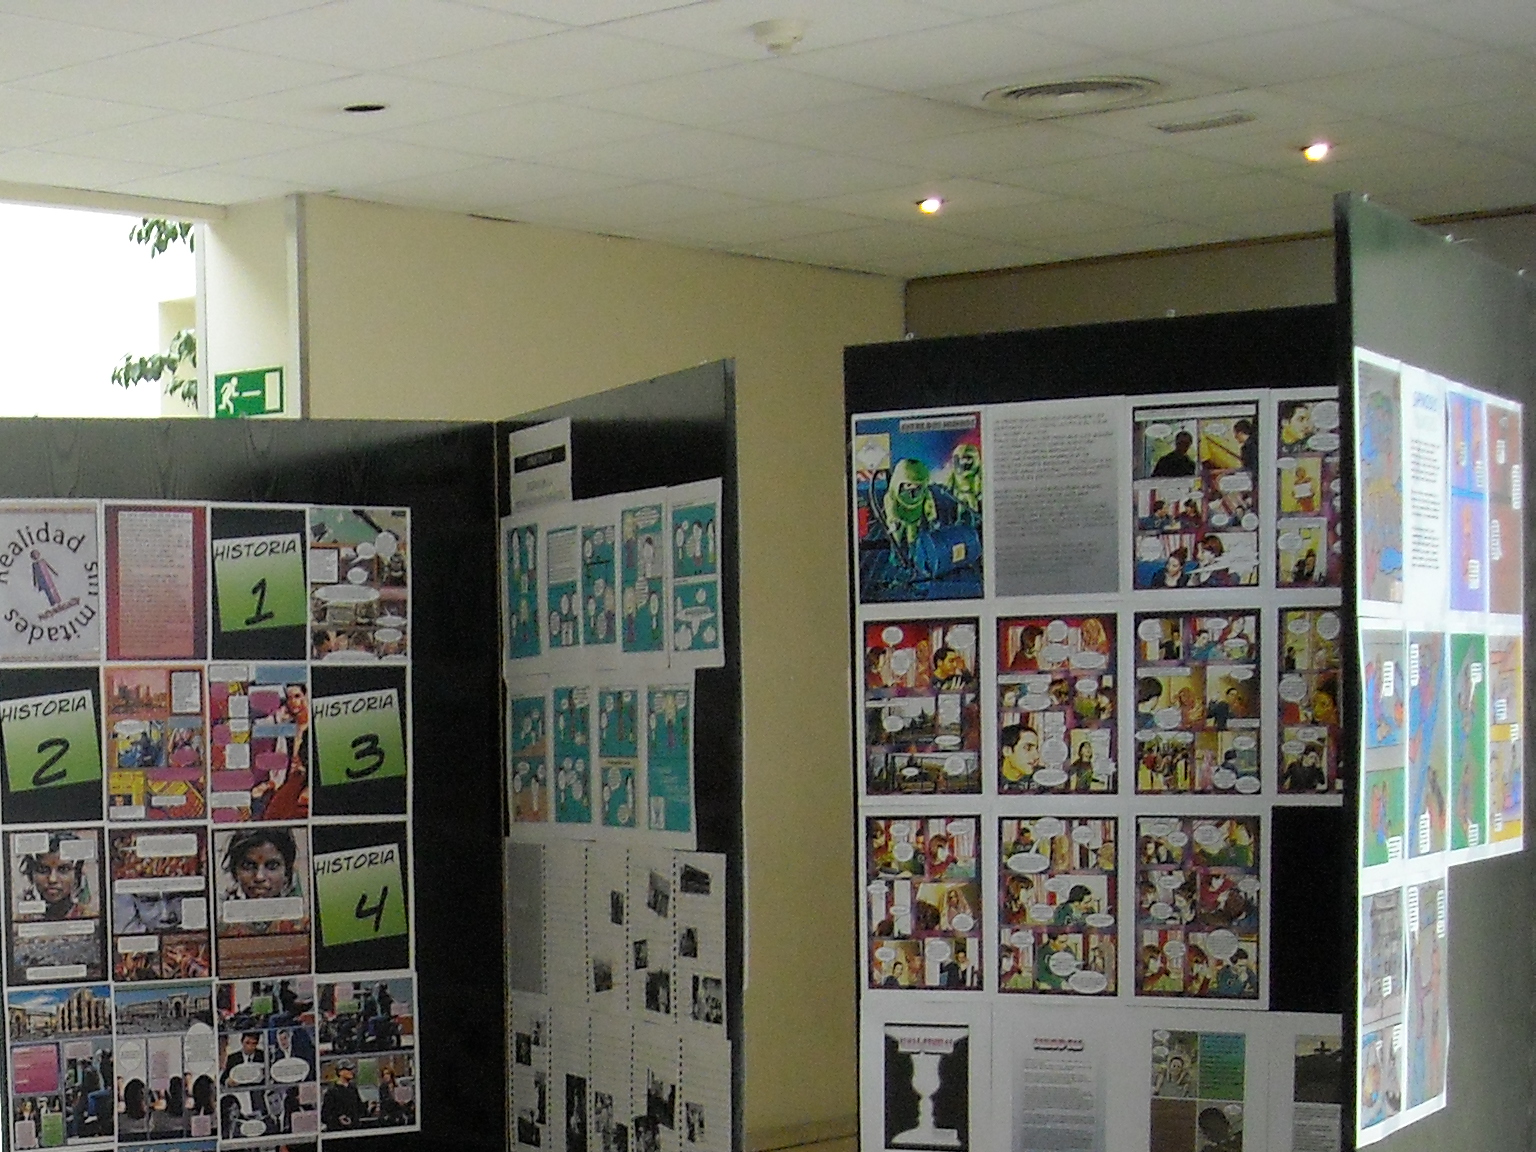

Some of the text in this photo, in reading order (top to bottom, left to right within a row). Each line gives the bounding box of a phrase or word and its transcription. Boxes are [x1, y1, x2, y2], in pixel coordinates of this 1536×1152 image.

[214, 540, 296, 561] HISTORIA
[245, 578, 274, 626] 1
[4, 604, 96, 645] mitades
[1, 695, 86, 722] HISTORIA
[313, 693, 394, 719] HISTORIA
[32, 737, 70, 786] 2
[345, 733, 385, 779] 3
[316, 848, 395, 875] HISTORIA
[355, 885, 388, 933] 4
